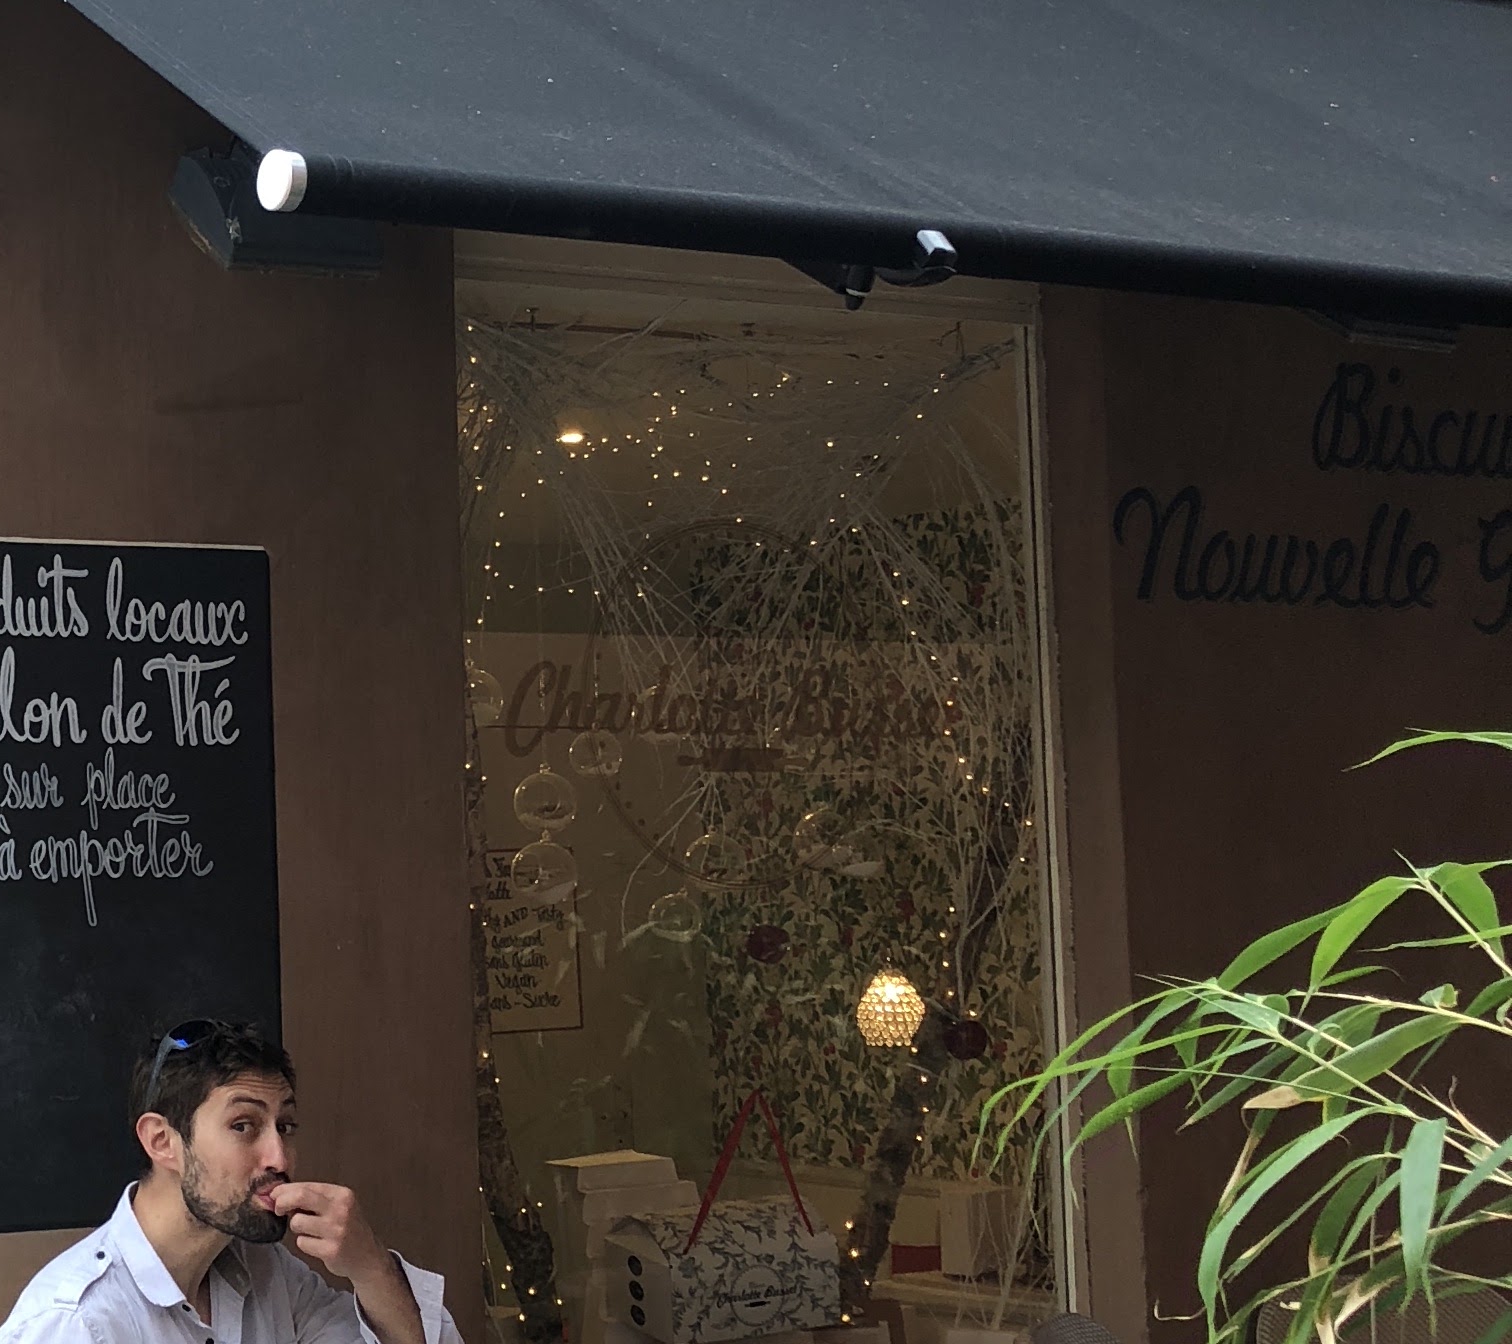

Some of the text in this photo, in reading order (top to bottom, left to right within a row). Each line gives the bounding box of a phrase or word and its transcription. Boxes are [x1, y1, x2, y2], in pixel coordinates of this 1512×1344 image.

[1112, 484, 1441, 609] Nouvelle
[106, 557, 249, 646] locaux
[101, 656, 153, 745] de
[142, 652, 240, 747] Thé
[0, 746, 175, 831] sur place
[29, 807, 214, 927] emporter
